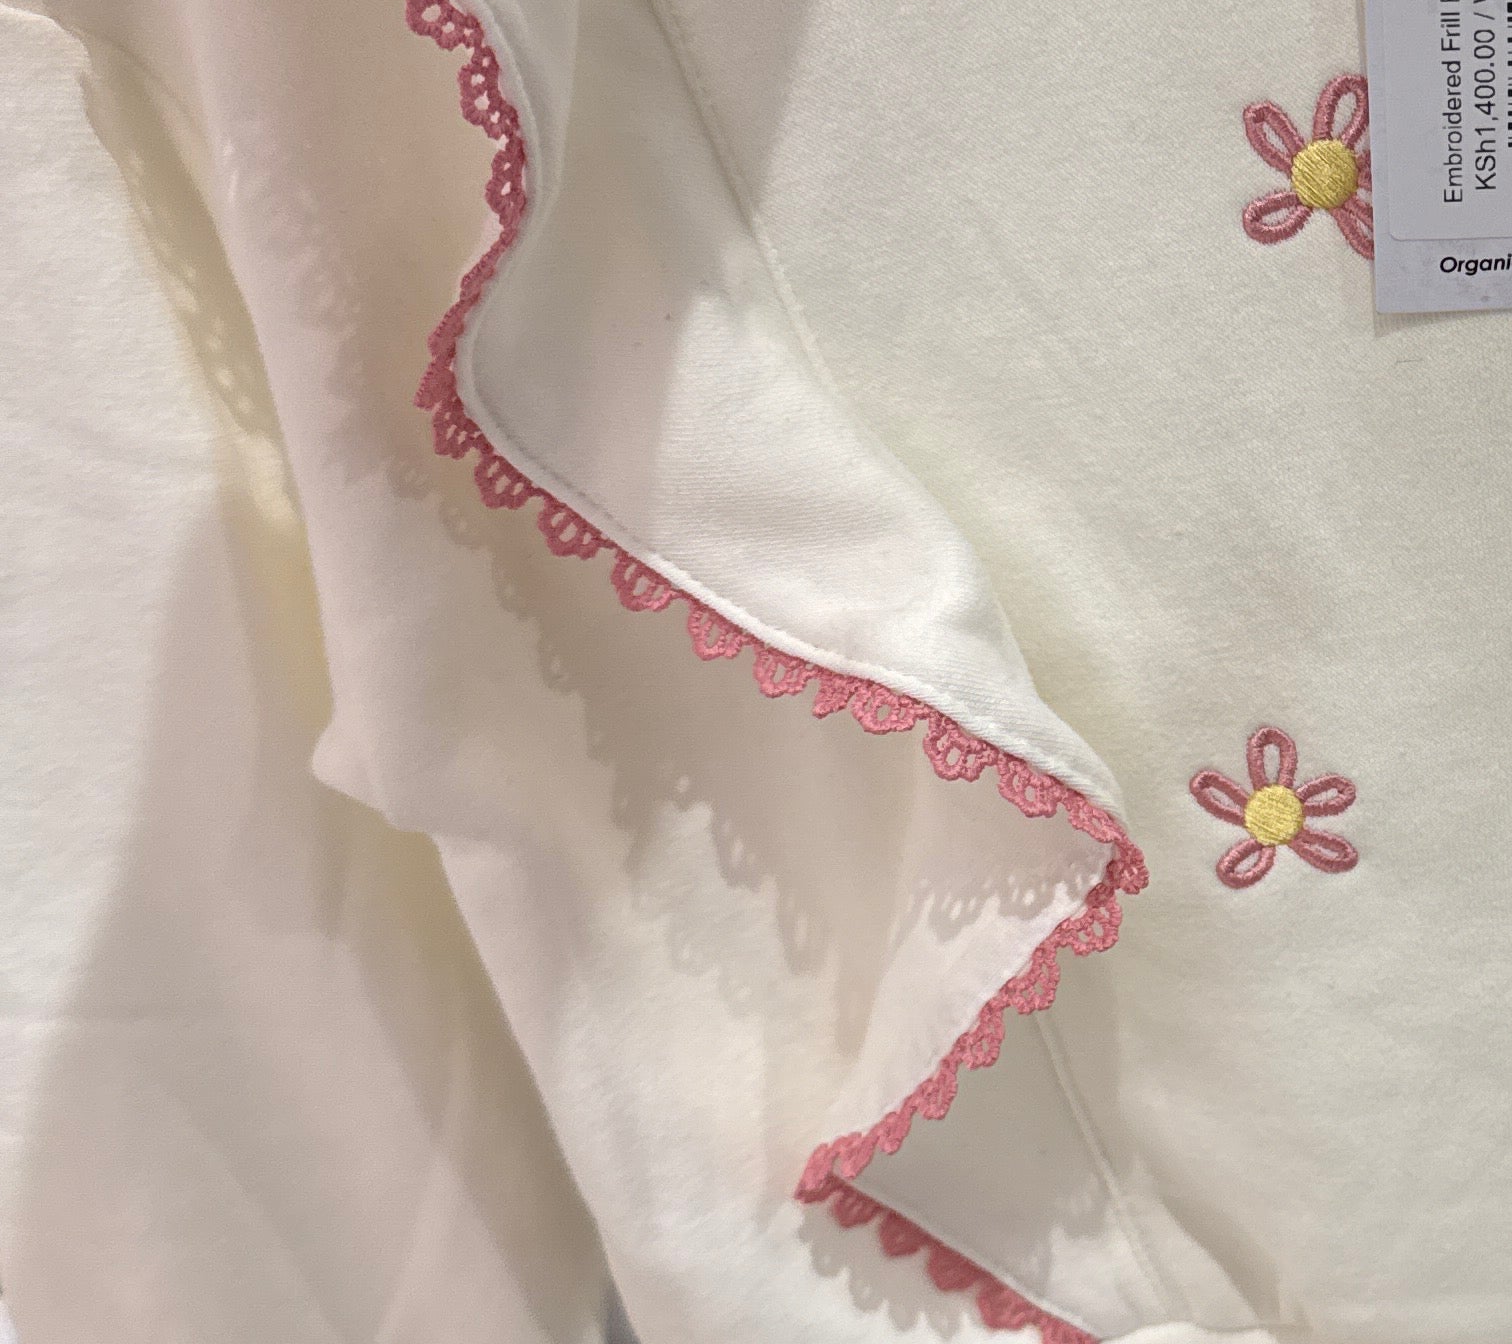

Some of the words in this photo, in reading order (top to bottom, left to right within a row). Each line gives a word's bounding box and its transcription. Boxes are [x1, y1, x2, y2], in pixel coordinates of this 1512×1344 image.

[1440, 11, 1461, 52] Frill
[1440, 60, 1463, 203] Embroidered
[1473, 28, 1498, 191] KSh1,400.00
